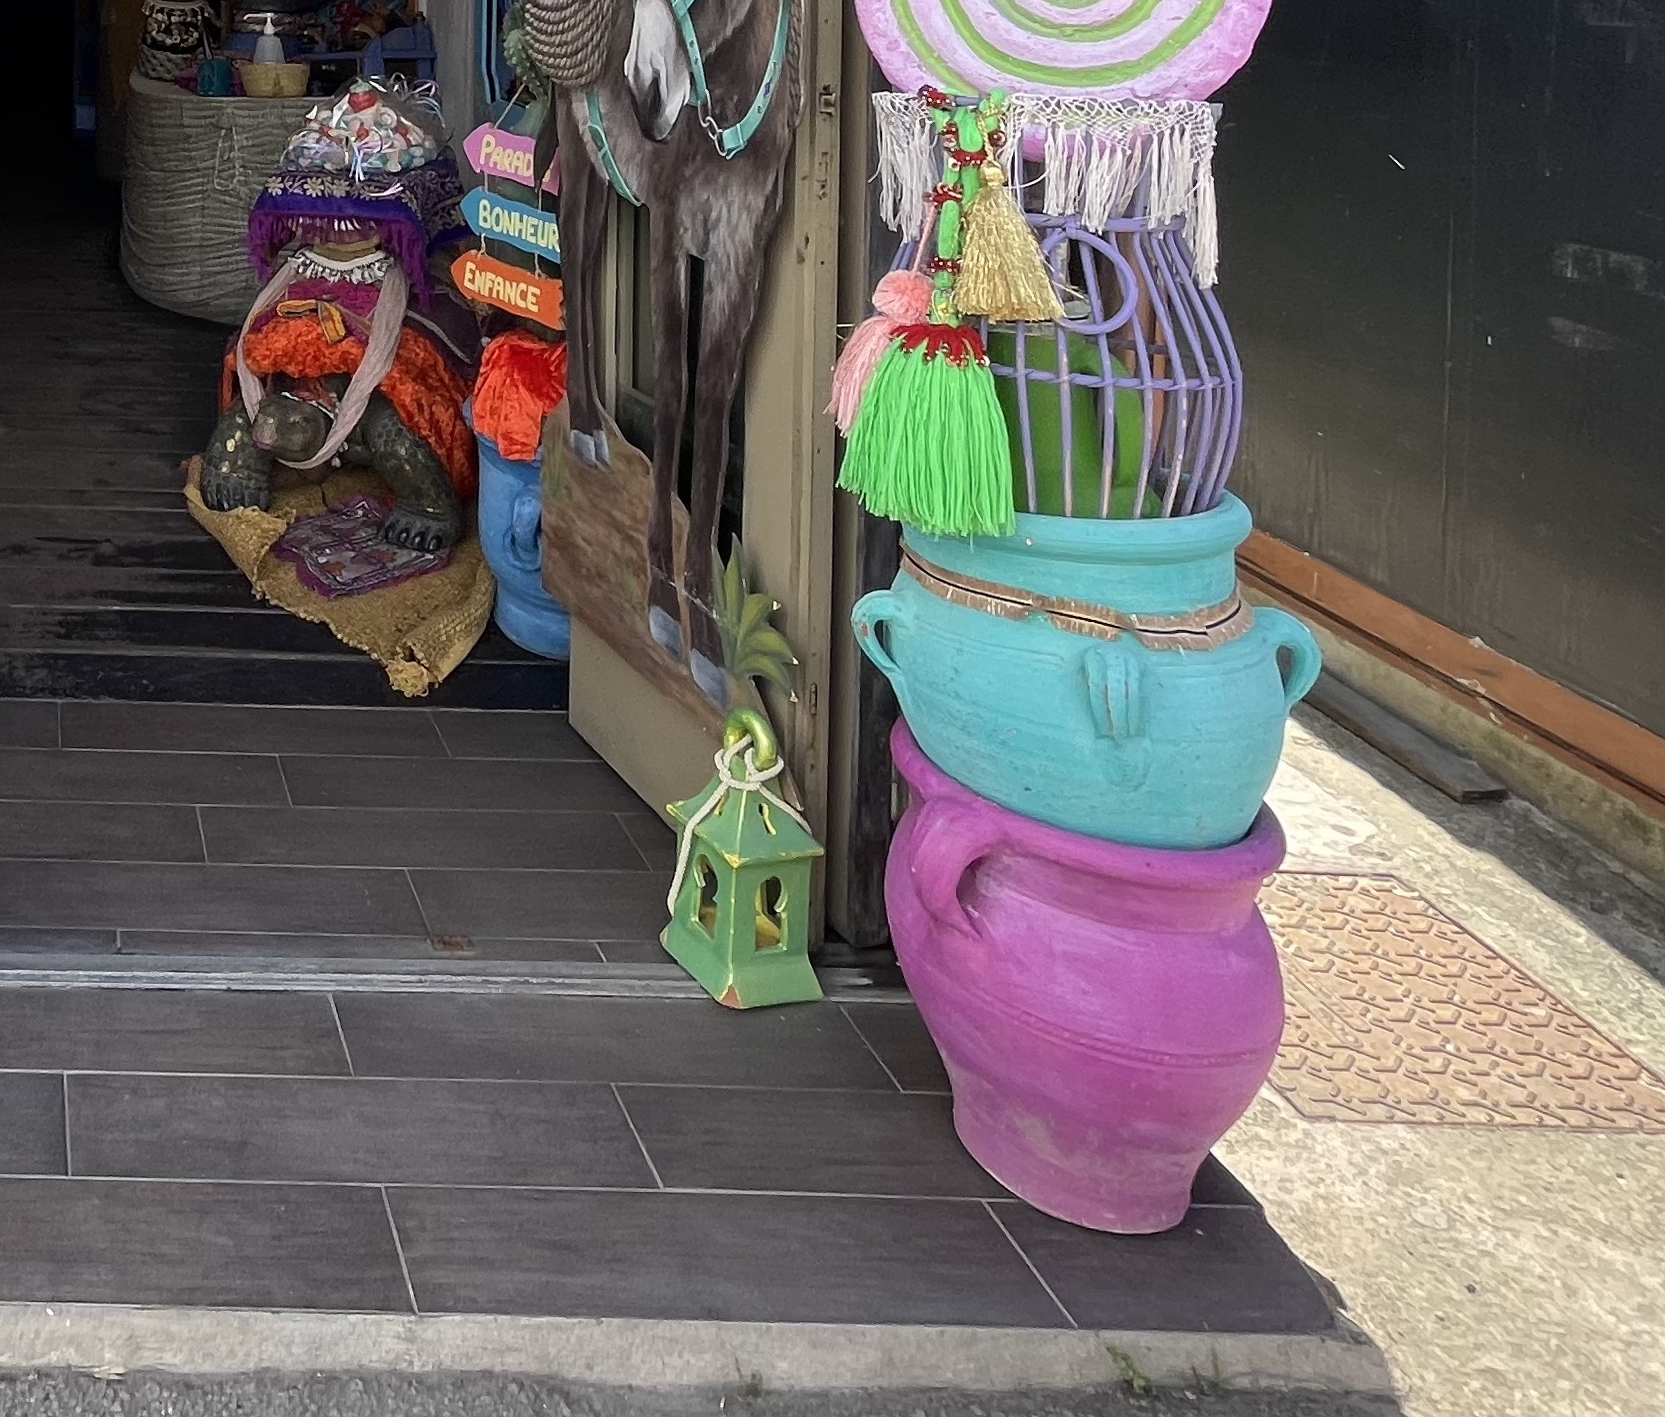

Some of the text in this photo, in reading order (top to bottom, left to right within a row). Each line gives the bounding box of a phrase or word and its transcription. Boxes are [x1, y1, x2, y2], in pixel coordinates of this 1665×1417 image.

[480, 134, 553, 182] PARAD
[479, 199, 561, 253] BONHEUR
[464, 261, 542, 313] ENFANCE
